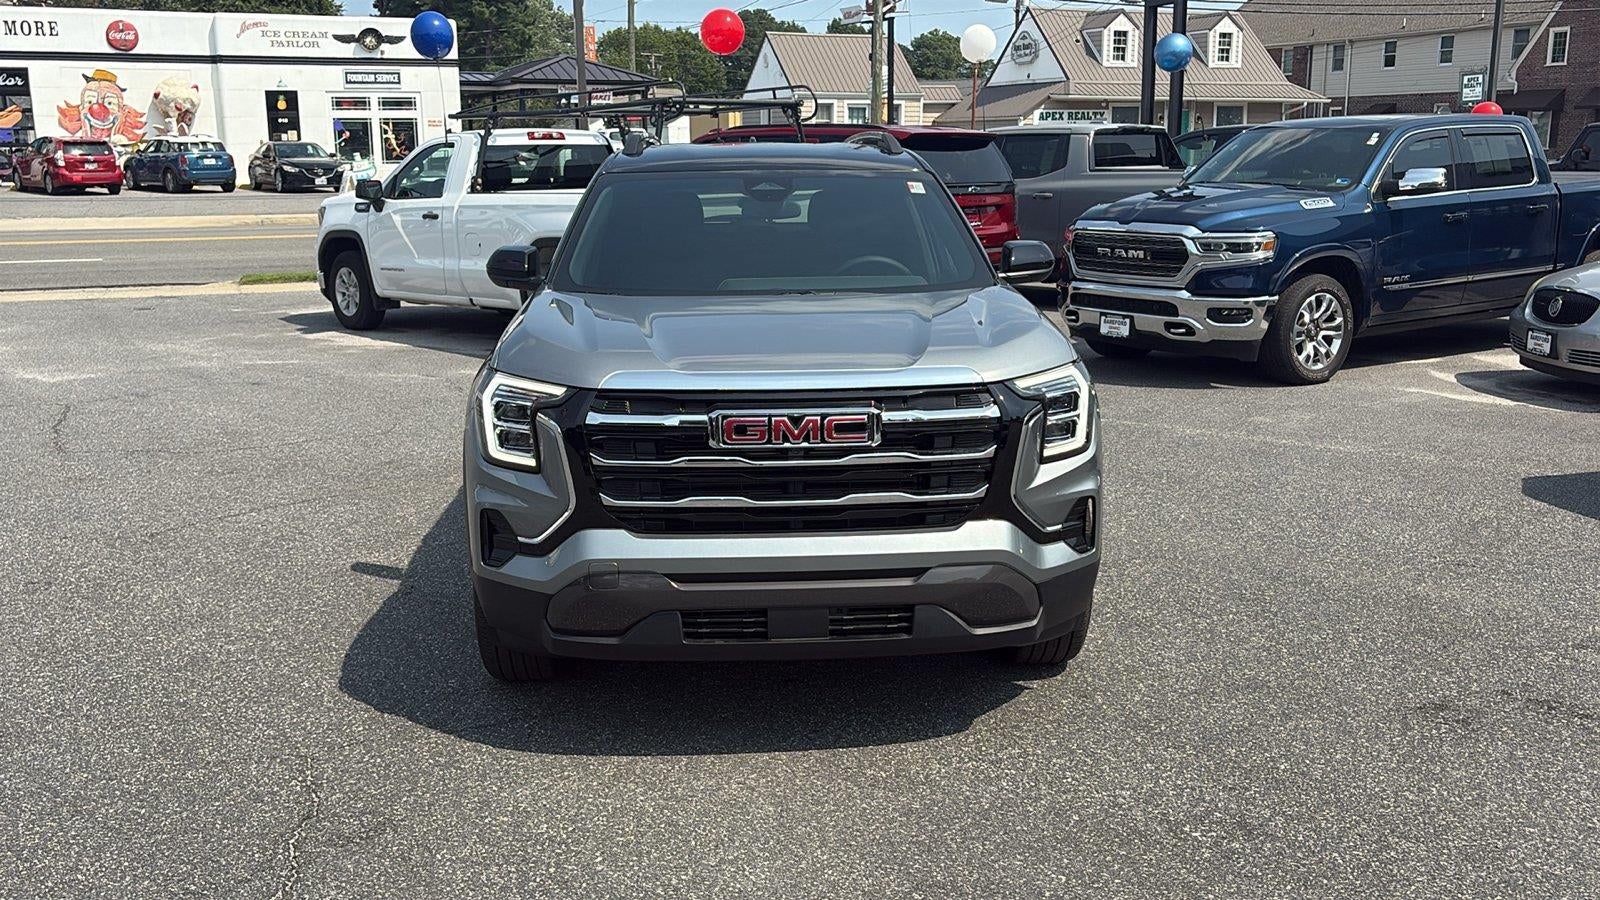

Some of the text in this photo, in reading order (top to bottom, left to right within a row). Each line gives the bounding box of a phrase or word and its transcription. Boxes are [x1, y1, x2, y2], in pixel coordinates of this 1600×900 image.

[2, 19, 59, 37] MORE
[260, 30, 329, 39] ICE CREAM
[270, 40, 320, 48] PARLOR
[375, 73, 399, 83] SERVICE
[1038, 111, 1106, 121] APEX REALTY
[1096, 246, 1145, 259] RAM
[724, 415, 868, 443] GMC
